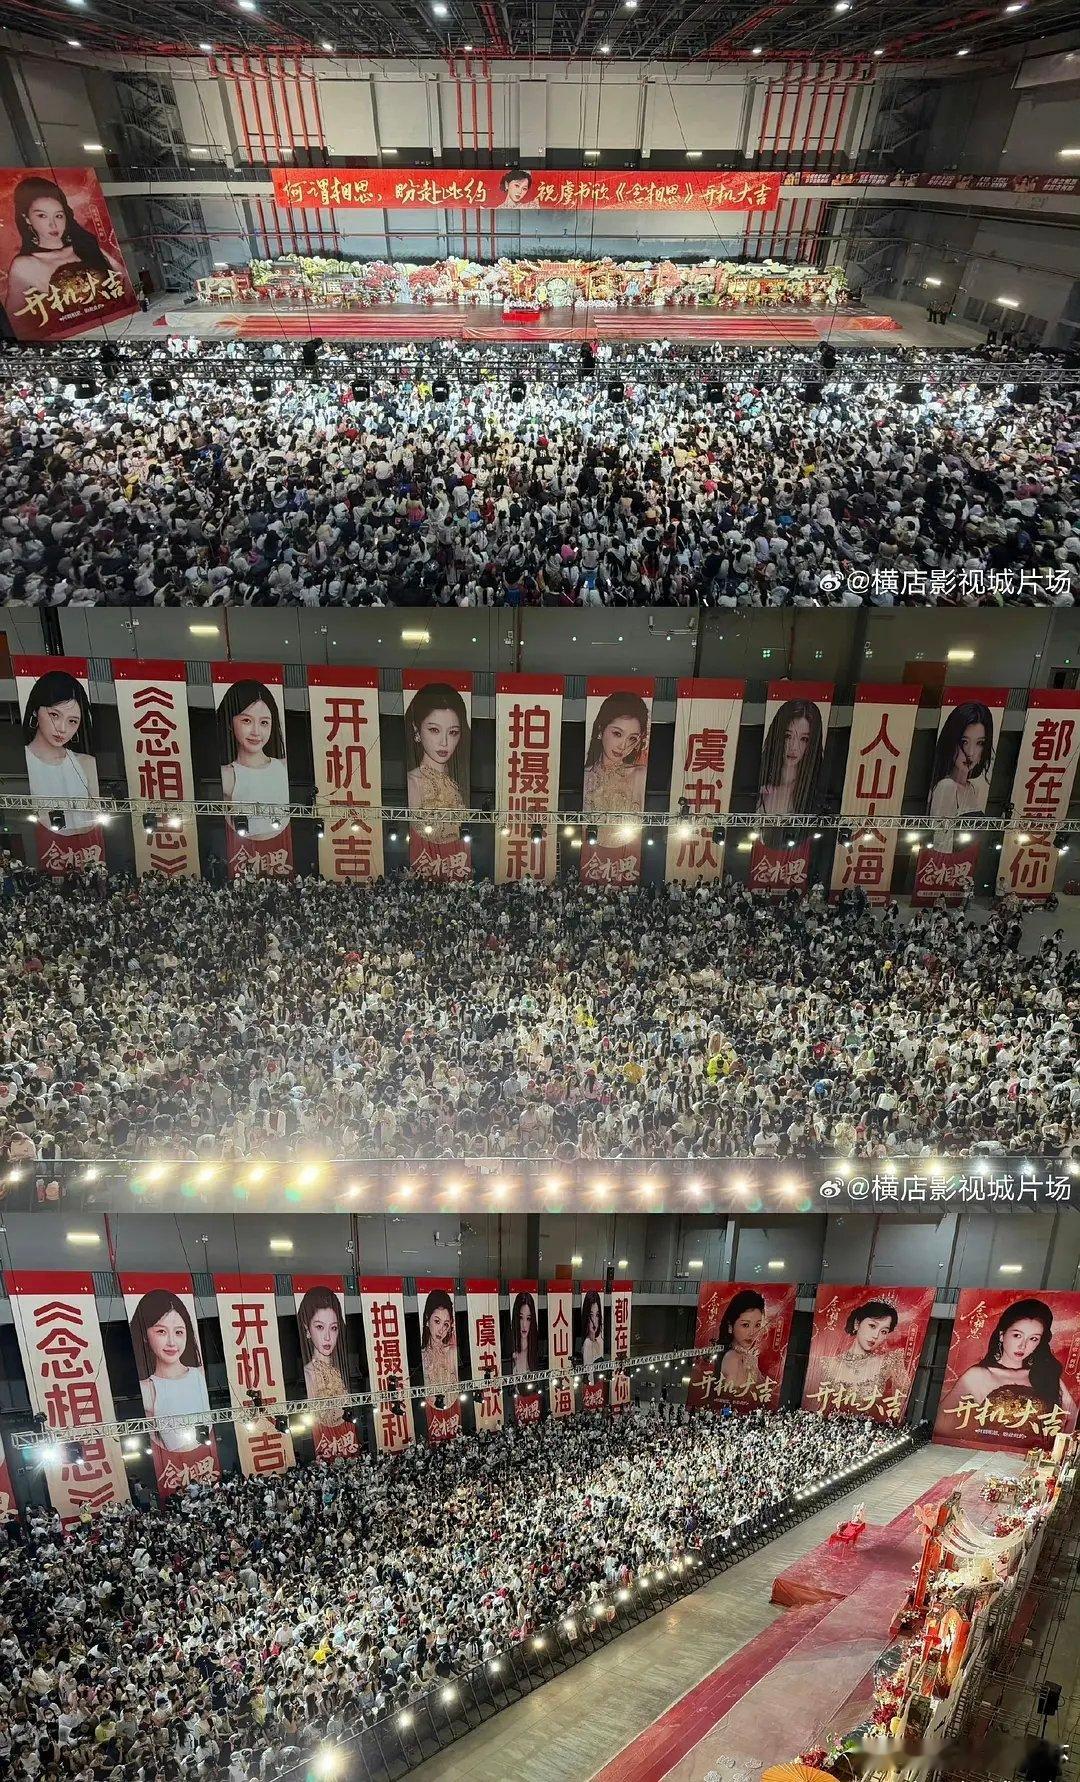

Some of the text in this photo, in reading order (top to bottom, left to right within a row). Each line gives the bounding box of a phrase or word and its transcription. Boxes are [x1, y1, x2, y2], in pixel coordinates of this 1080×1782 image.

[13, 269, 125, 327] 开机大吉
[324, 697, 373, 876] 开机大吉
[507, 704, 550, 879] 拍摄顺利
[229, 845, 293, 876] 念相思
[411, 848, 471, 879] 念相思
[581, 851, 640, 881] 念相思
[751, 855, 808, 885] 念相思
[917, 857, 974, 887] 念相思
[692, 1370, 778, 1403] 开机大吉
[806, 1381, 908, 1418] 开机大吉
[943, 1393, 1071, 1436] 开机大吉
[315, 1430, 359, 1458] 念相思
